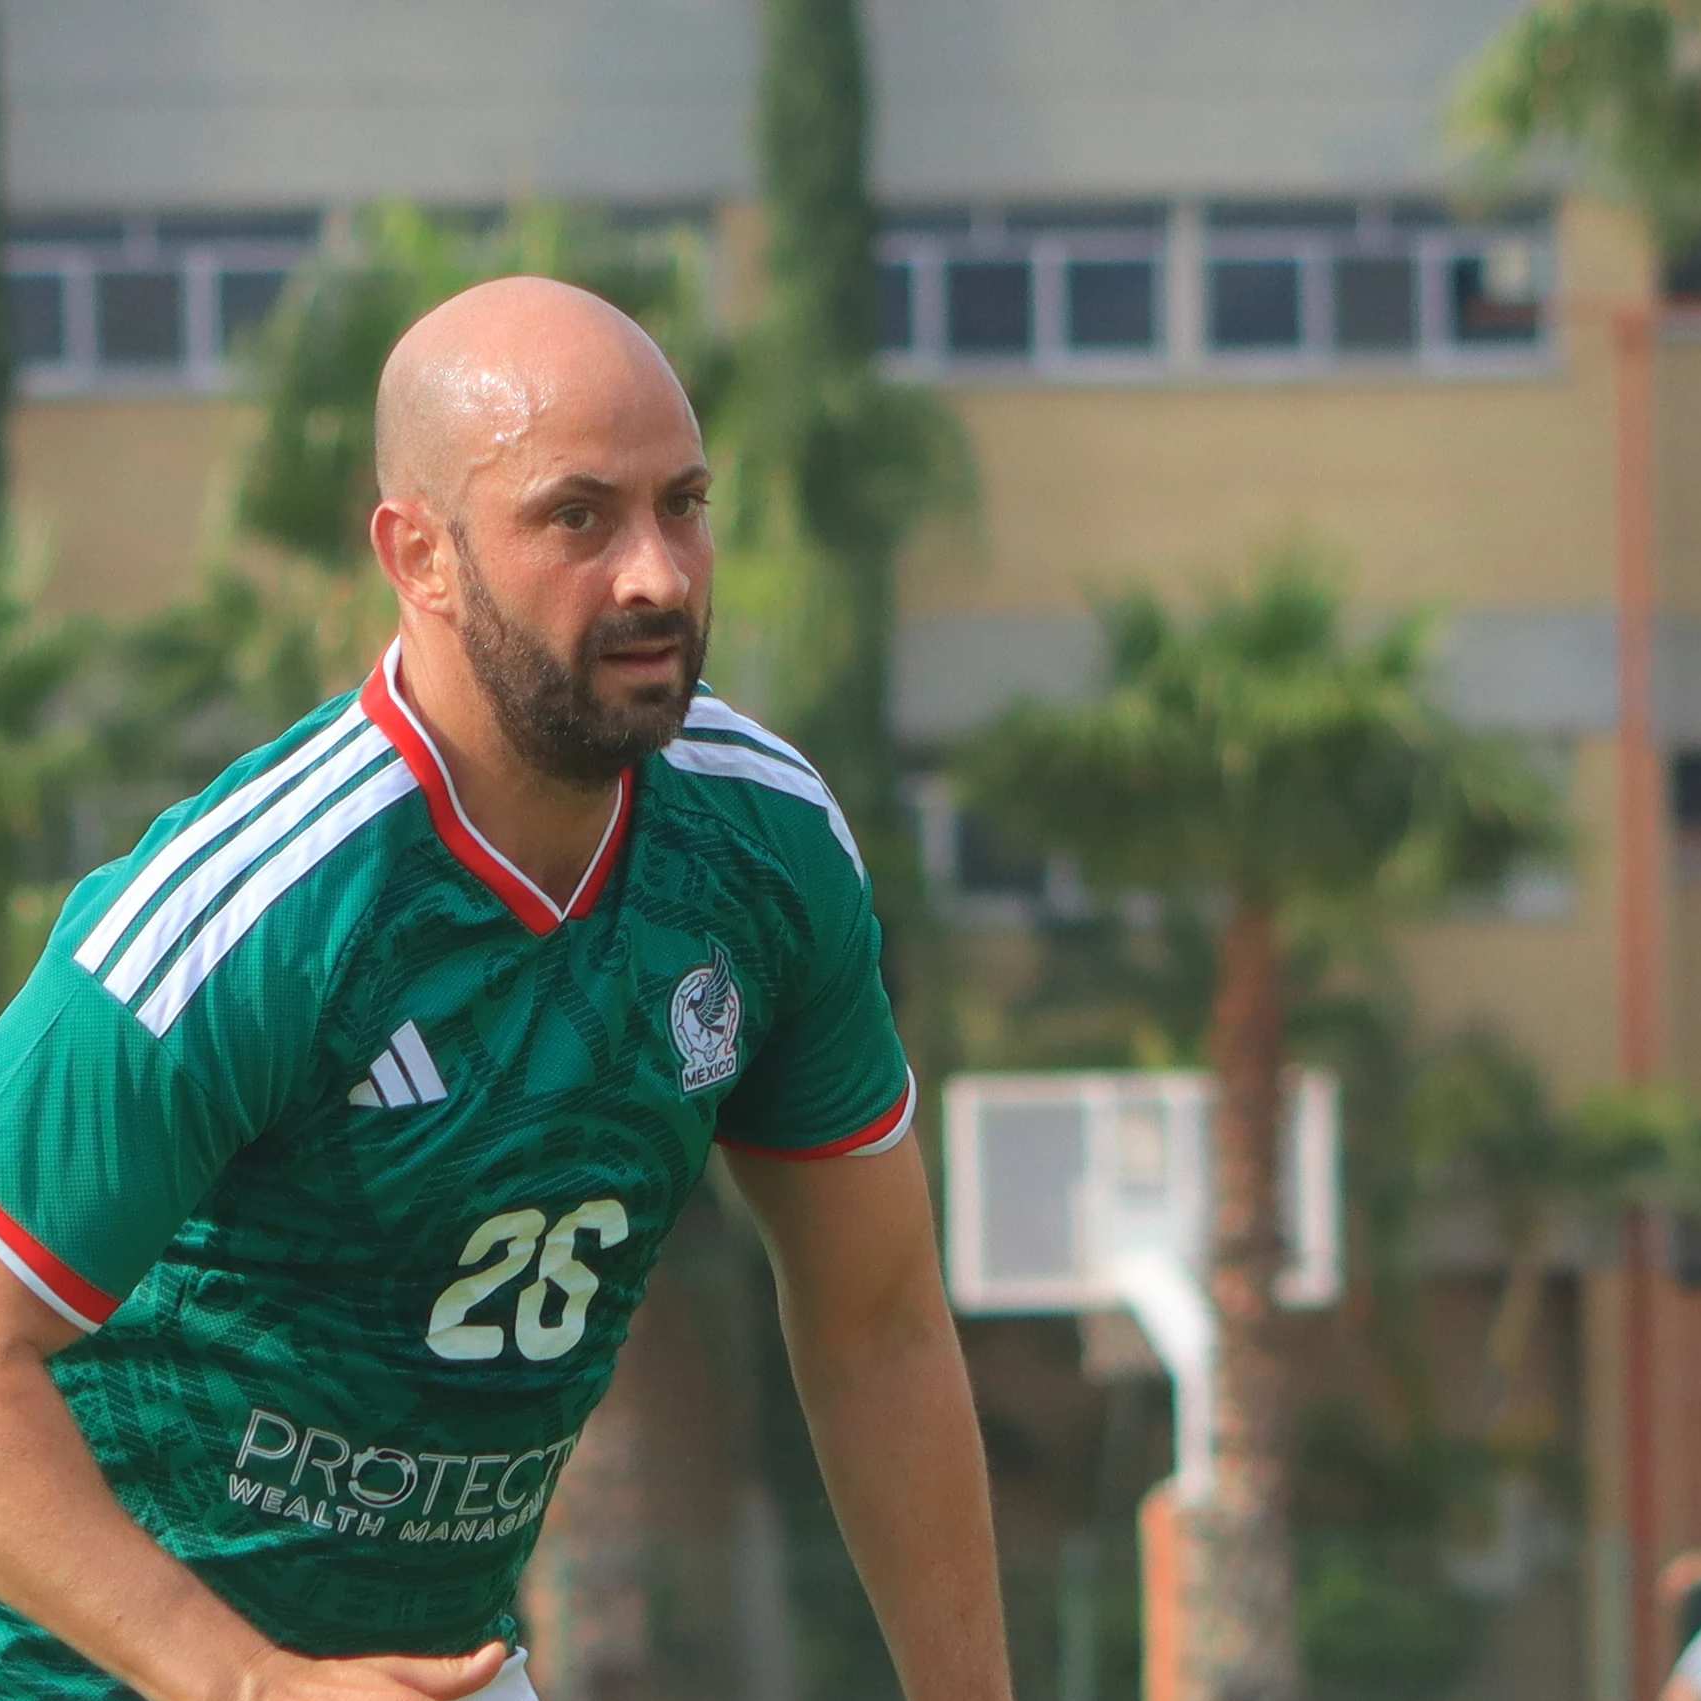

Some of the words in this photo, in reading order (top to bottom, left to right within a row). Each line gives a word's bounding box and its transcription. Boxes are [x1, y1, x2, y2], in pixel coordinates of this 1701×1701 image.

[683, 1057, 735, 1090] MÉXICO
[425, 1199, 629, 1361] 26
[228, 1473, 386, 1538] WEALTH
